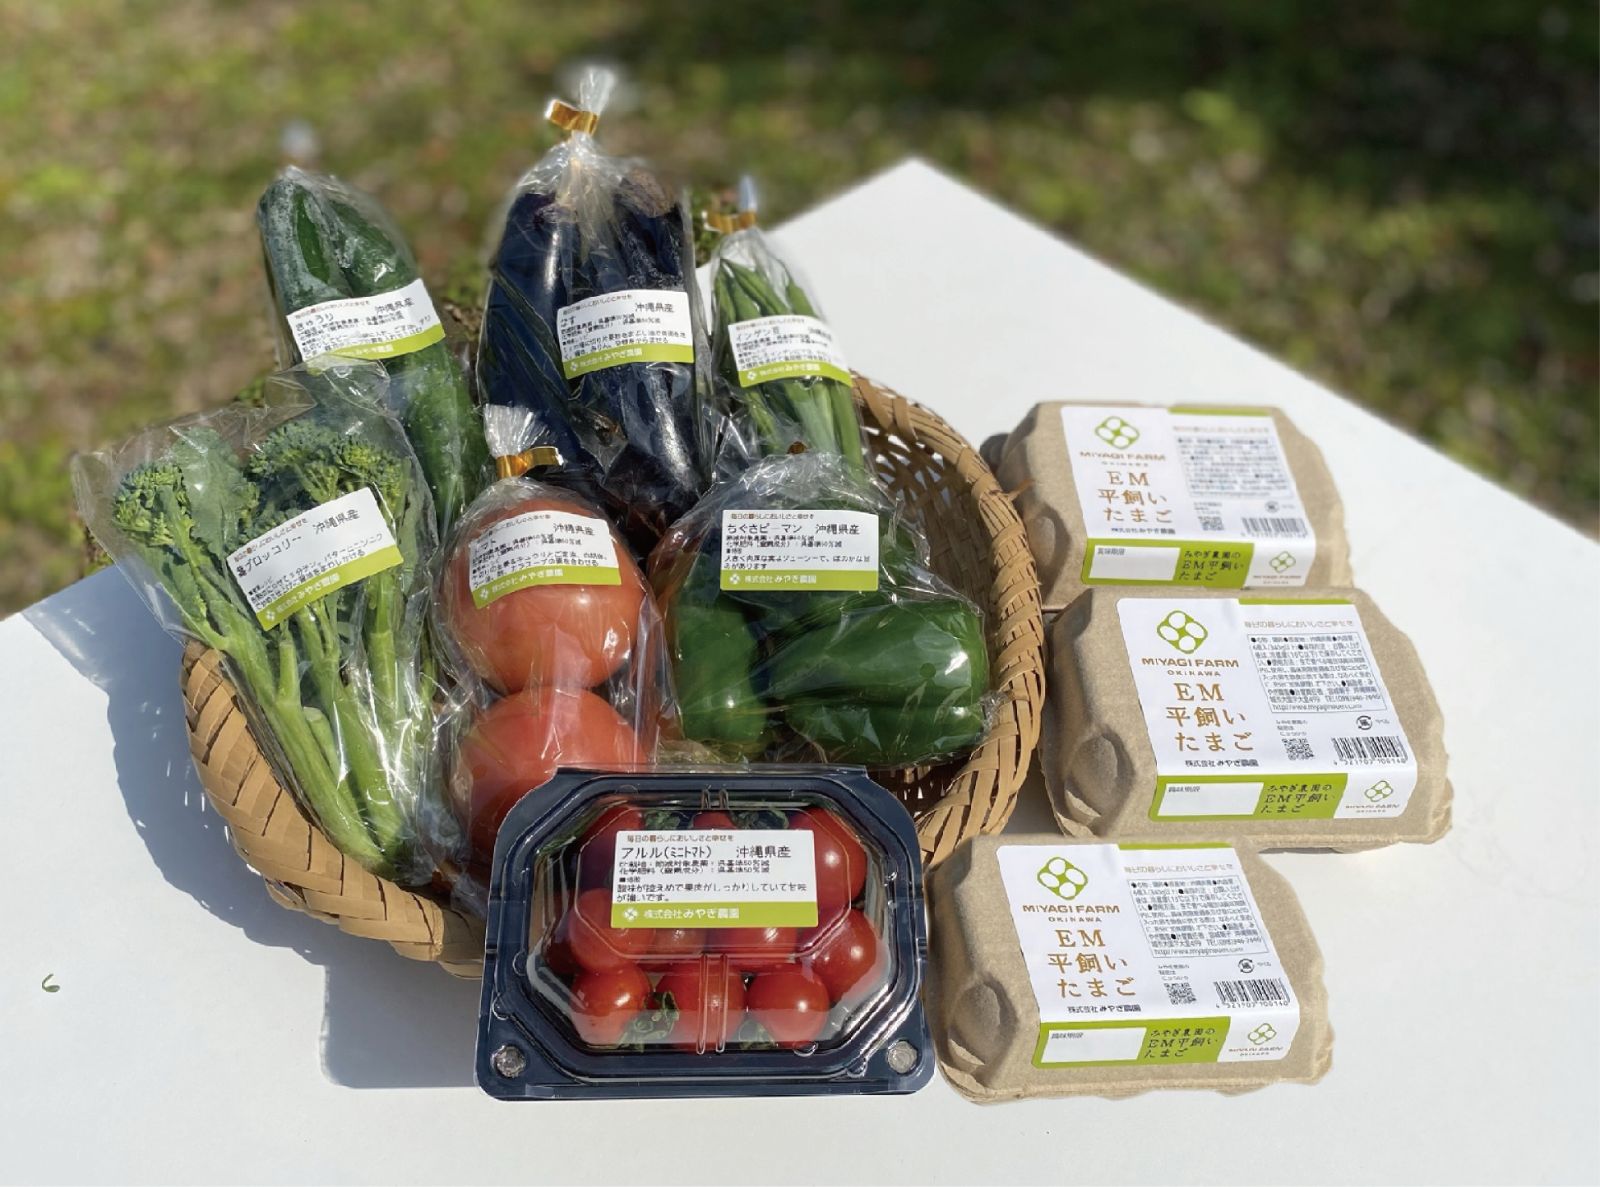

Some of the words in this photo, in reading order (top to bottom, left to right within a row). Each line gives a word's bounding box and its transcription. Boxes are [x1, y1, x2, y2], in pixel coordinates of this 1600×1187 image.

[635, 302, 674, 313] 沖縄県産
[1107, 471, 1150, 486] EM
[1097, 489, 1167, 505] 平飼い
[312, 509, 360, 535] 沖縄県産
[1103, 507, 1173, 523] たまご
[553, 522, 595, 536] 沖縄県産
[727, 523, 803, 534] ちぐさピーマン
[815, 523, 860, 535] 沖縄県産
[1195, 659, 1239, 668] FARM
[1173, 682, 1224, 701] EM
[1165, 706, 1246, 728] 平飼い
[1175, 732, 1253, 752] たまご
[736, 845, 791, 858] 沖縄県産
[644, 908, 740, 919] 株式会社みやぎ農園
[1076, 905, 1120, 913] FARM
[1055, 929, 1106, 947] EM
[1048, 952, 1127, 974] 平飼い
[1057, 977, 1136, 998] たまご
